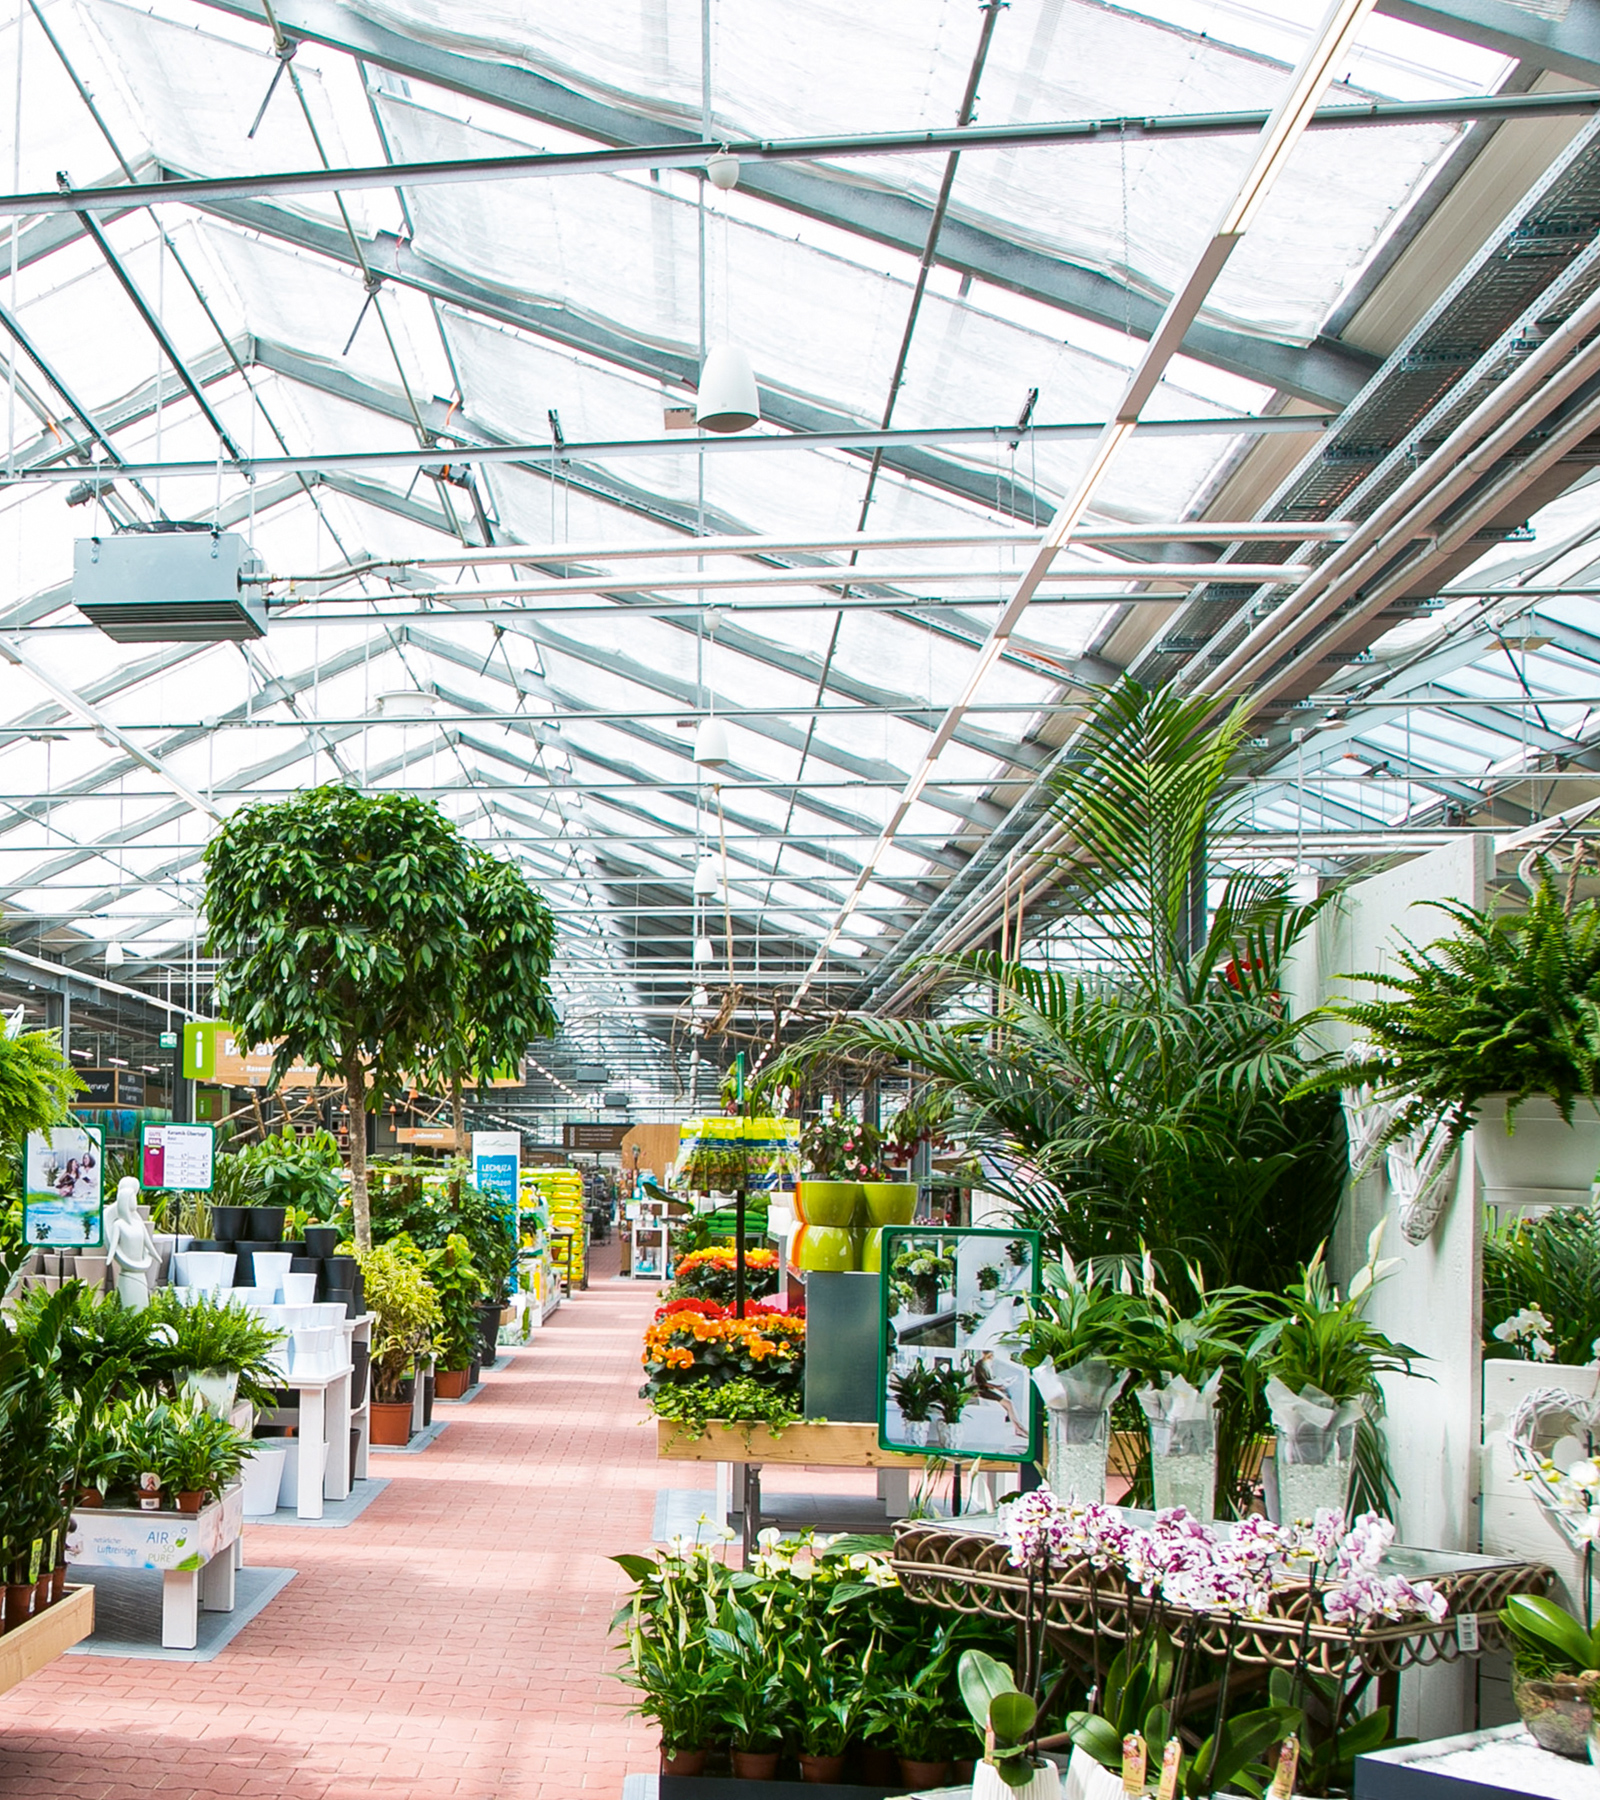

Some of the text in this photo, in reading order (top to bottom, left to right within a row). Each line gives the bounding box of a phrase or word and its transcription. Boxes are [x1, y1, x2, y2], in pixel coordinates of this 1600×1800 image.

[146, 1530, 169, 1544] AIR
[97, 1544, 138, 1557] Luftreiniger
[163, 1545, 175, 1553] SO
